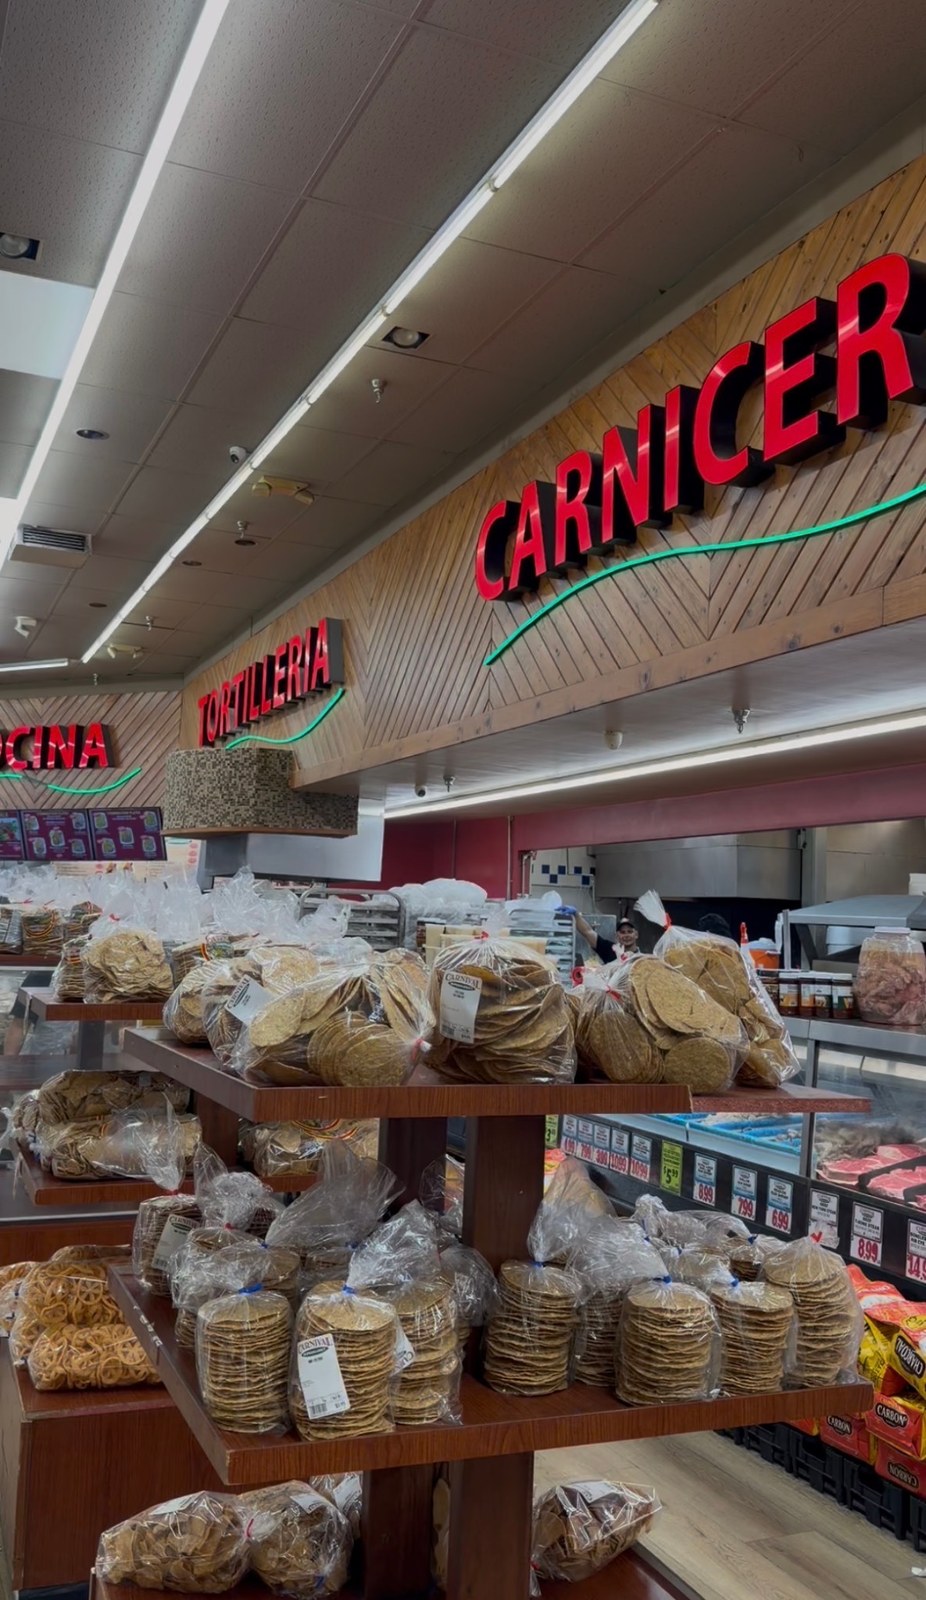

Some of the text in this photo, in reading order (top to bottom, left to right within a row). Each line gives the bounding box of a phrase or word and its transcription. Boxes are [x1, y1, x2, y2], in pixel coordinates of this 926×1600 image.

[475, 253, 916, 601] CARNICER
[197, 616, 331, 748] TORTILLERIA
[0, 722, 109, 771] CINA
[445, 973, 481, 990] CARNIVAL
[857, 1238, 878, 1262] 8.99
[895, 1336, 924, 1376] CHARCOAL
[828, 1415, 851, 1434] CARBON
[877, 1404, 907, 1427] CARBON
[889, 1462, 917, 1486] CARBON
